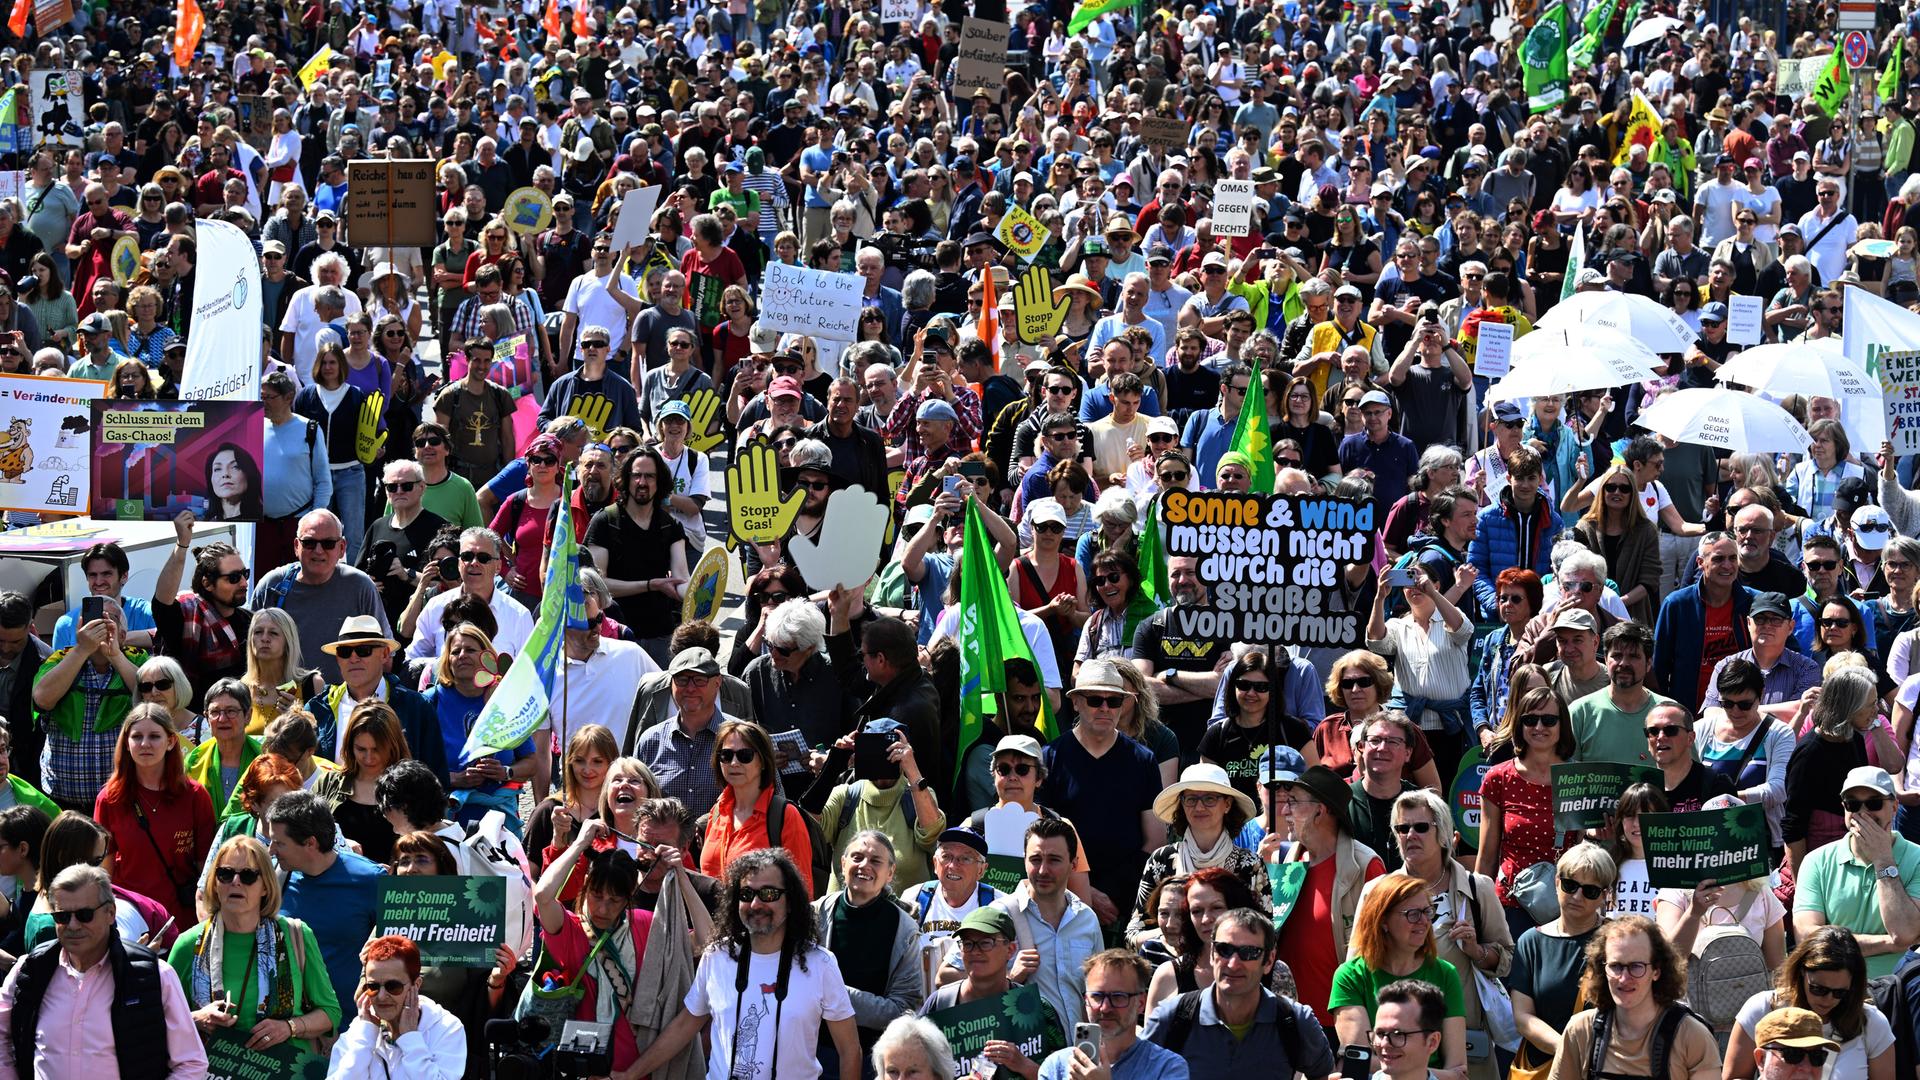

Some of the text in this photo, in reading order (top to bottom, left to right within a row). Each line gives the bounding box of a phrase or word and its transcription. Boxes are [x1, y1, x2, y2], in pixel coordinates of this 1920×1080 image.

[1220, 184, 1248, 193] OMAS
[392, 199, 416, 208] dumm
[1218, 204, 1248, 213] GEGEN
[356, 210, 388, 219] verkaufe
[1214, 224, 1247, 233] RECHTS
[772, 266, 852, 290] Back to the
[792, 289, 834, 307] future
[767, 311, 855, 333] weg mit Reiche!
[1025, 312, 1053, 324] Stopp
[1598, 319, 1617, 328] OMAS
[1027, 323, 1047, 334] Gas!
[13, 390, 91, 409] Veränderung
[106, 413, 201, 426] Schluss mit dem
[1707, 416, 1730, 424] OMAS
[1704, 424, 1730, 433] GEGEN
[106, 430, 172, 442] Gas-Chaos!
[1699, 433, 1728, 443] RECHTS
[741, 506, 779, 517] Stopp
[1166, 492, 1374, 531] Sonne & Wind
[744, 518, 772, 530] Gas!
[1170, 525, 1367, 560] müssen nicht
[1200, 553, 1336, 587] durch die
[1215, 582, 1322, 615] Straße
[1179, 609, 1357, 644] von Hormus
[1226, 758, 1258, 770] GRÜN
[1240, 769, 1258, 777] HERZ
[1558, 773, 1624, 786] Mehr Sonne,
[1559, 785, 1619, 797] mehr Wind,
[1560, 797, 1598, 813] mehr
[1648, 826, 1718, 838] Mehr Sonne,
[1650, 838, 1714, 851] mehr Wind,
[1653, 844, 1759, 869] mehr Freiheit!
[384, 890, 457, 906] Mehr Sonne,
[383, 907, 450, 923] mehr Wind,
[383, 924, 497, 942] mehr Freiheit!
[944, 1015, 1000, 1039] hr Sonne,
[208, 1054, 239, 1072] mehr
[212, 1039, 282, 1074] Mehr Sonne,
